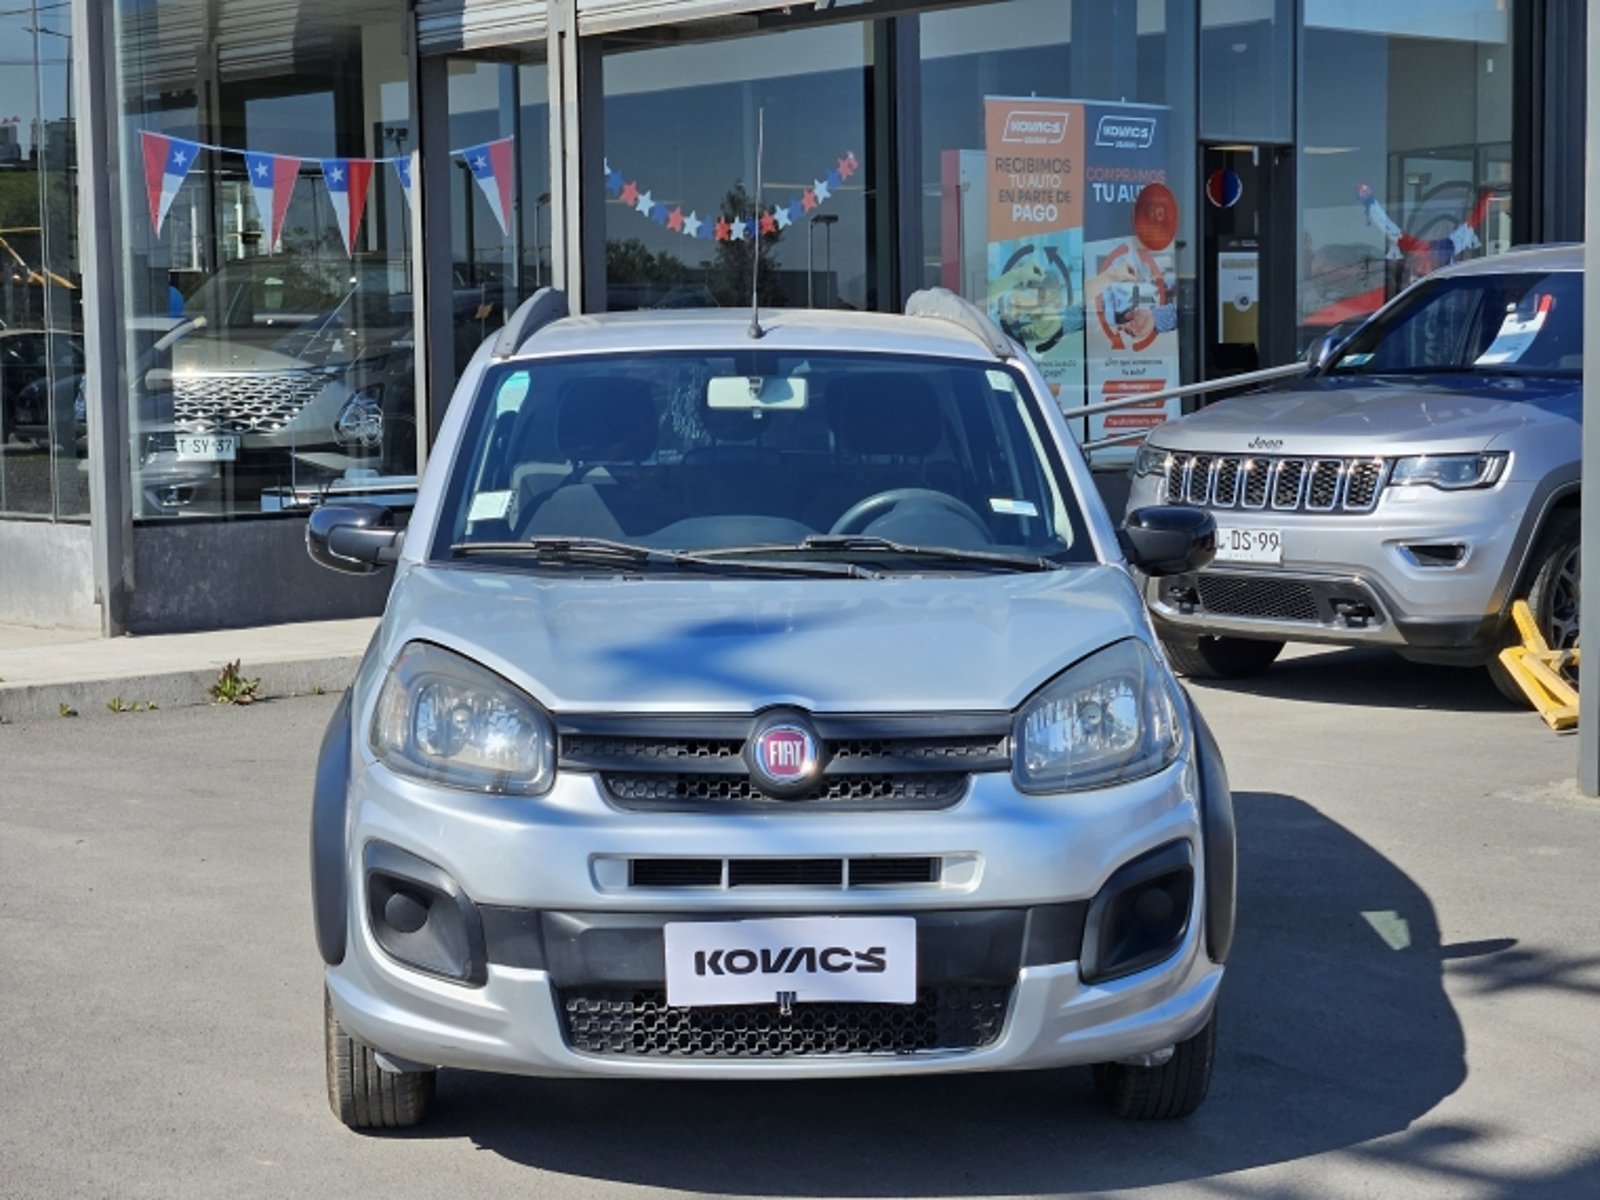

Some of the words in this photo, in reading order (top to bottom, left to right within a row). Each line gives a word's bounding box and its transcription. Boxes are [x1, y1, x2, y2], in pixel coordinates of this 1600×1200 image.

[995, 158, 1072, 173] RECIBIMOS
[1009, 174, 1026, 188] TU
[1027, 174, 1062, 188] AUTO
[1087, 168, 1166, 182] COMPRAMOS
[999, 189, 1014, 202] EN
[1018, 189, 1054, 203] PARTE
[1056, 191, 1072, 203] DE
[1092, 182, 1115, 202] TU
[1117, 183, 1144, 203] AU
[1012, 204, 1058, 222] PAGO
[1248, 436, 1283, 449] Jeep
[769, 740, 802, 767] FIAT
[694, 946, 886, 976] KOVACS
